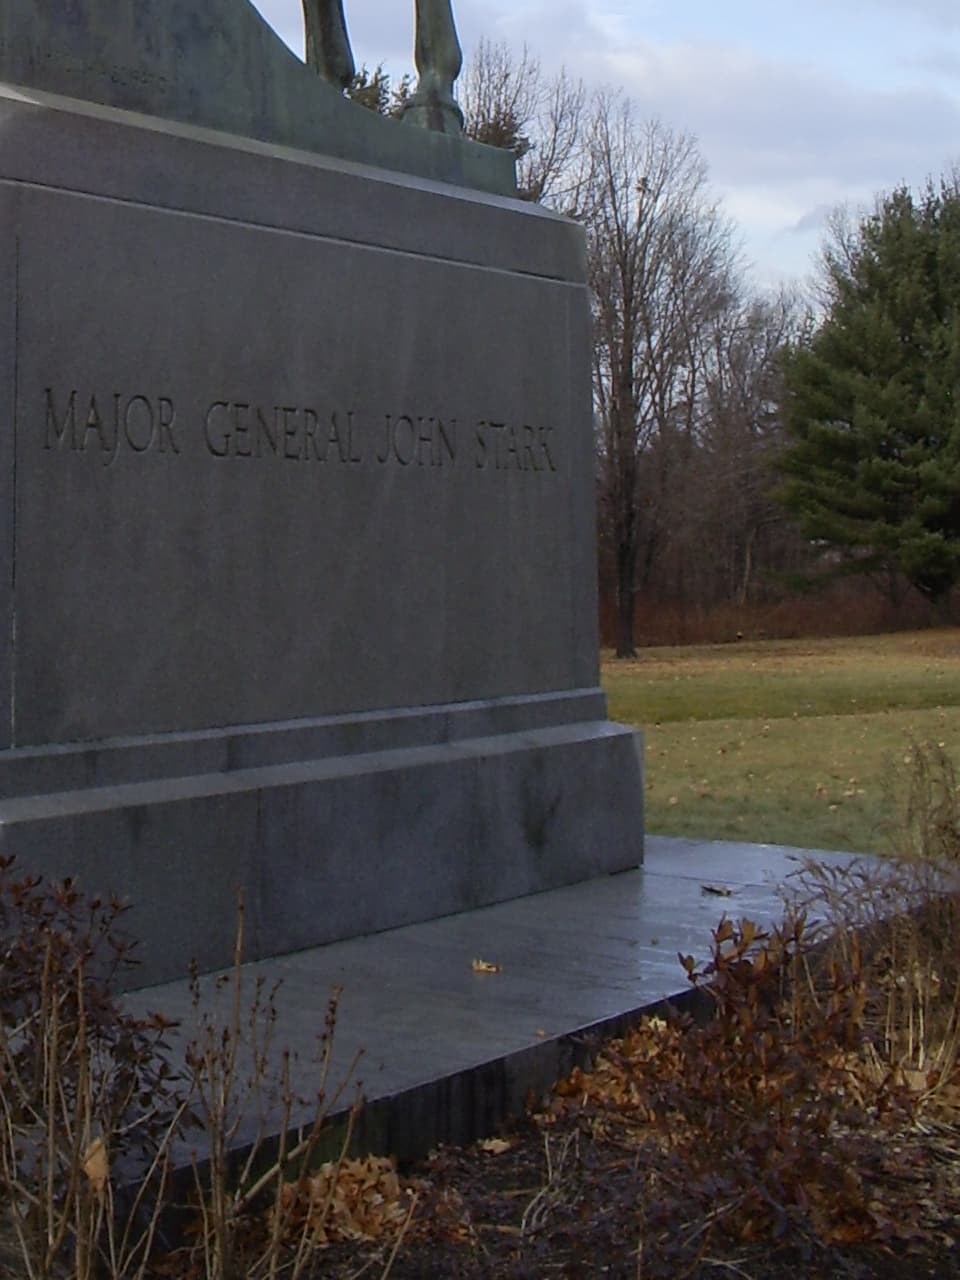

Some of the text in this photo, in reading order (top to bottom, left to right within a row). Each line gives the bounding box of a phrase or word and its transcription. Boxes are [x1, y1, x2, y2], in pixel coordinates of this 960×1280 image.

[42, 387, 558, 472] MAJOR GENERAL JOHN STARK
